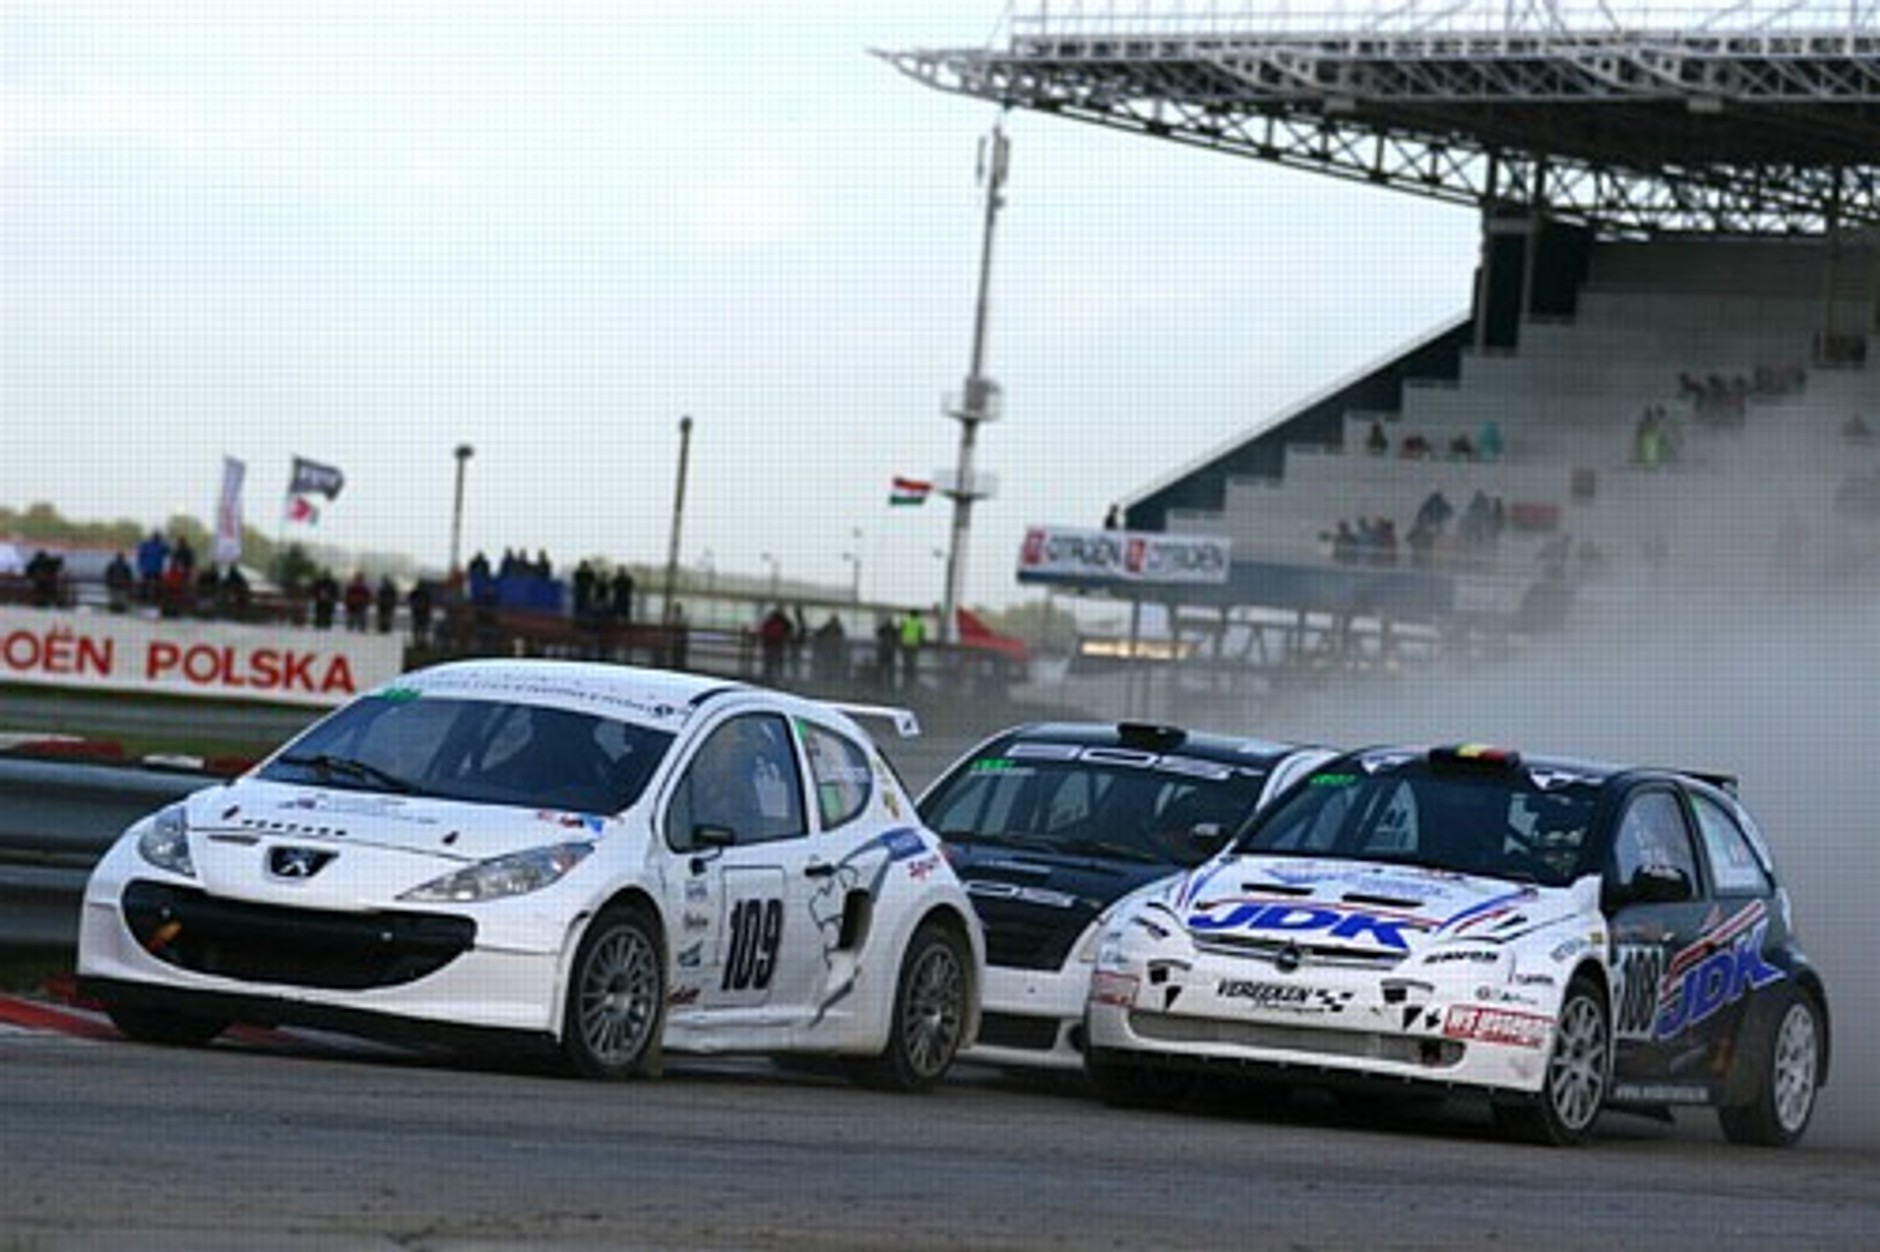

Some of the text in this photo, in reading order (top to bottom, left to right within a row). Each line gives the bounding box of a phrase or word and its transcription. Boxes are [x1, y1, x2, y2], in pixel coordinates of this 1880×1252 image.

[147, 641, 355, 694] POLSKA
[721, 898, 784, 991] 109
[1188, 903, 1409, 948] JDK
[1655, 918, 1786, 1040] JDK
